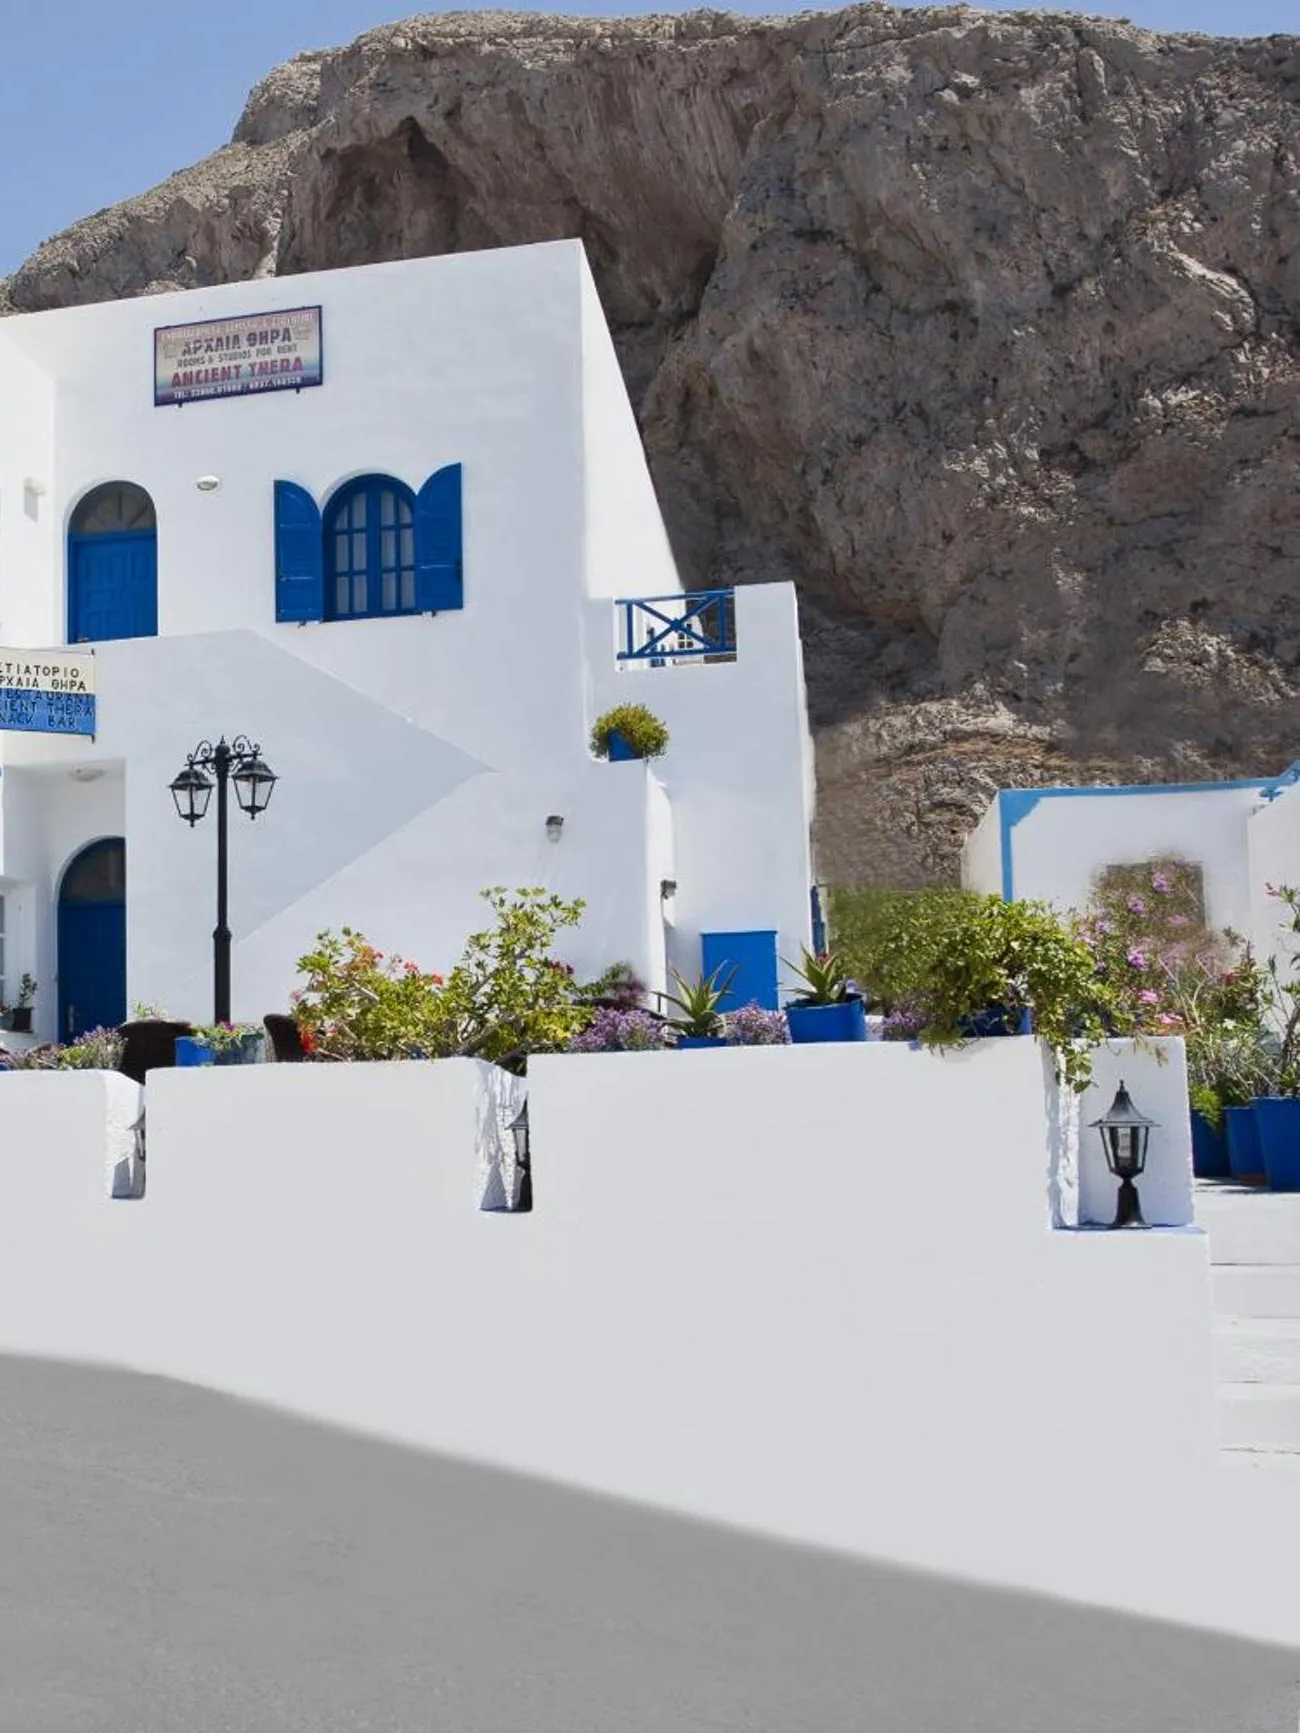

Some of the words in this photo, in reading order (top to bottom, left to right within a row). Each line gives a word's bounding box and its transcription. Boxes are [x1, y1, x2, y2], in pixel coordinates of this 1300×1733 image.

[181, 334, 241, 357] ΑΡΧΑΙΑ
[246, 327, 292, 348] ΘΗΡΑ
[177, 355, 205, 368] ROOMS
[218, 350, 252, 363] STUDIOS
[256, 346, 272, 357] FOR
[277, 344, 298, 355] RENT
[171, 364, 242, 388] ANCIENT
[249, 356, 304, 378] THERA
[51, 679, 87, 691] ΘΗΡΑ
[46, 702, 93, 717] THERA
[47, 715, 76, 728] BAR
